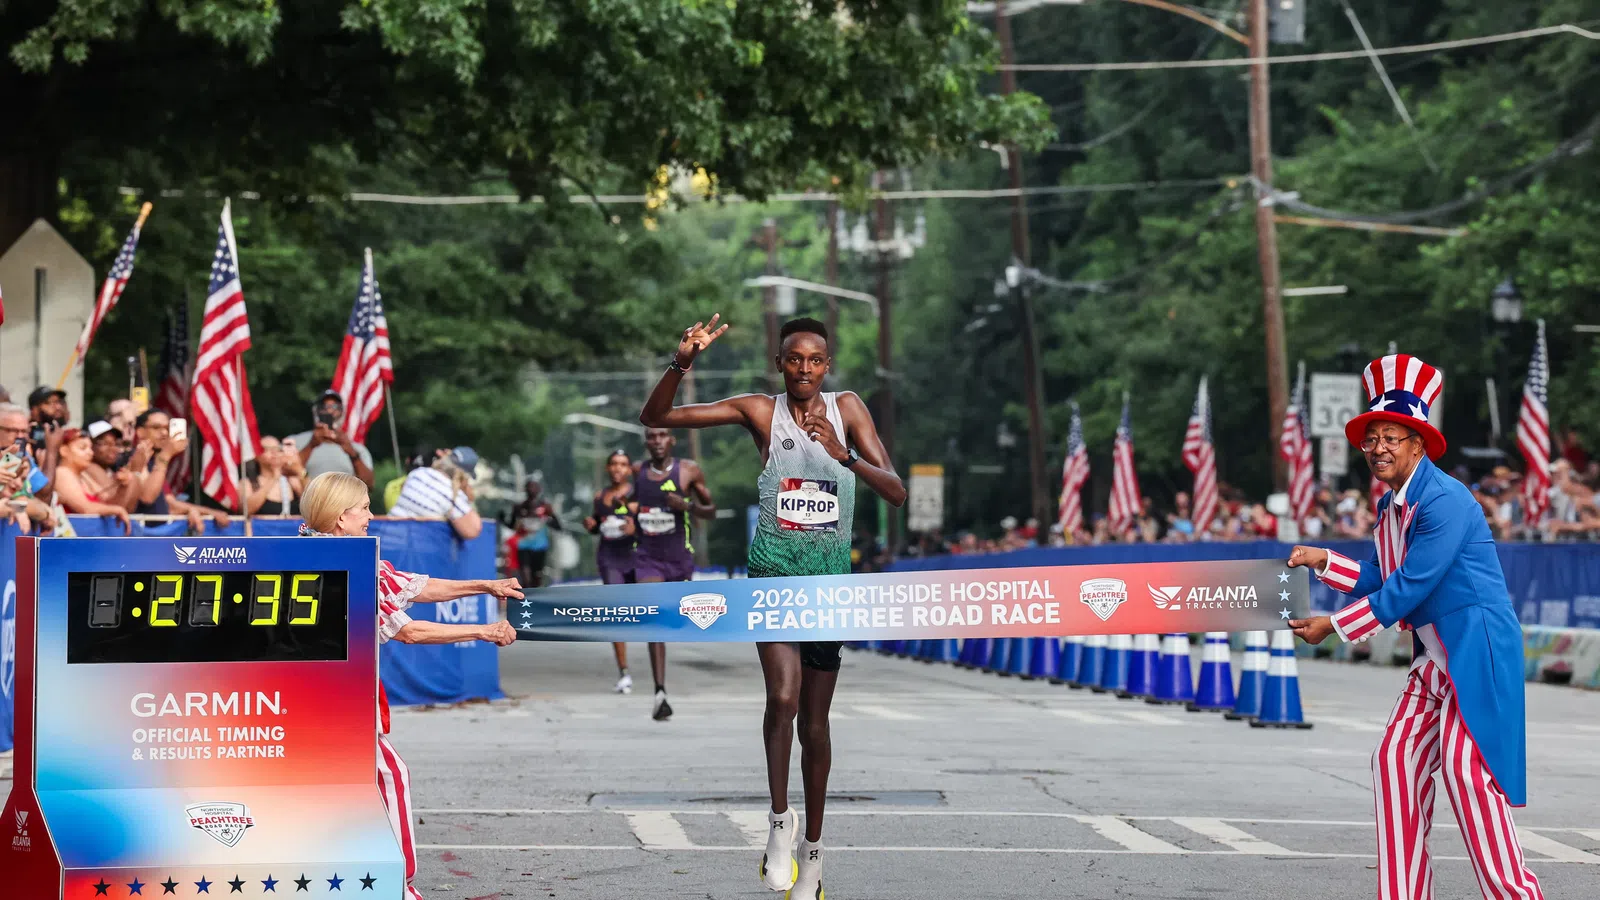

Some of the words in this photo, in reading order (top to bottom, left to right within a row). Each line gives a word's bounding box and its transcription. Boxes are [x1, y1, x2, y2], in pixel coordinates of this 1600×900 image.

[1317, 406, 1355, 428] 30
[781, 498, 835, 513] KIPROP
[199, 547, 247, 558] ATLANTA
[752, 588, 809, 608] 2026
[816, 583, 942, 606] NORTHSIDE
[950, 580, 1055, 602] HOSPITAL
[1082, 592, 1126, 600] PEACHTREE
[1186, 585, 1258, 601] ATLANTA
[553, 605, 659, 616] NORTHSIDE
[681, 605, 726, 613] PEACHTREE
[1186, 602, 1222, 610] TRACK
[1229, 601, 1258, 609] CLUB
[748, 606, 904, 631] PEACHTREE
[912, 604, 983, 627] ROAD
[991, 602, 1061, 625] RACE
[132, 727, 212, 743] OFFICIAL
[217, 726, 285, 742] TIMING
[131, 747, 144, 761] &
[149, 746, 212, 760] RESULTS
[217, 745, 285, 759] PARTNER
[190, 816, 253, 826] PEACHTREE
